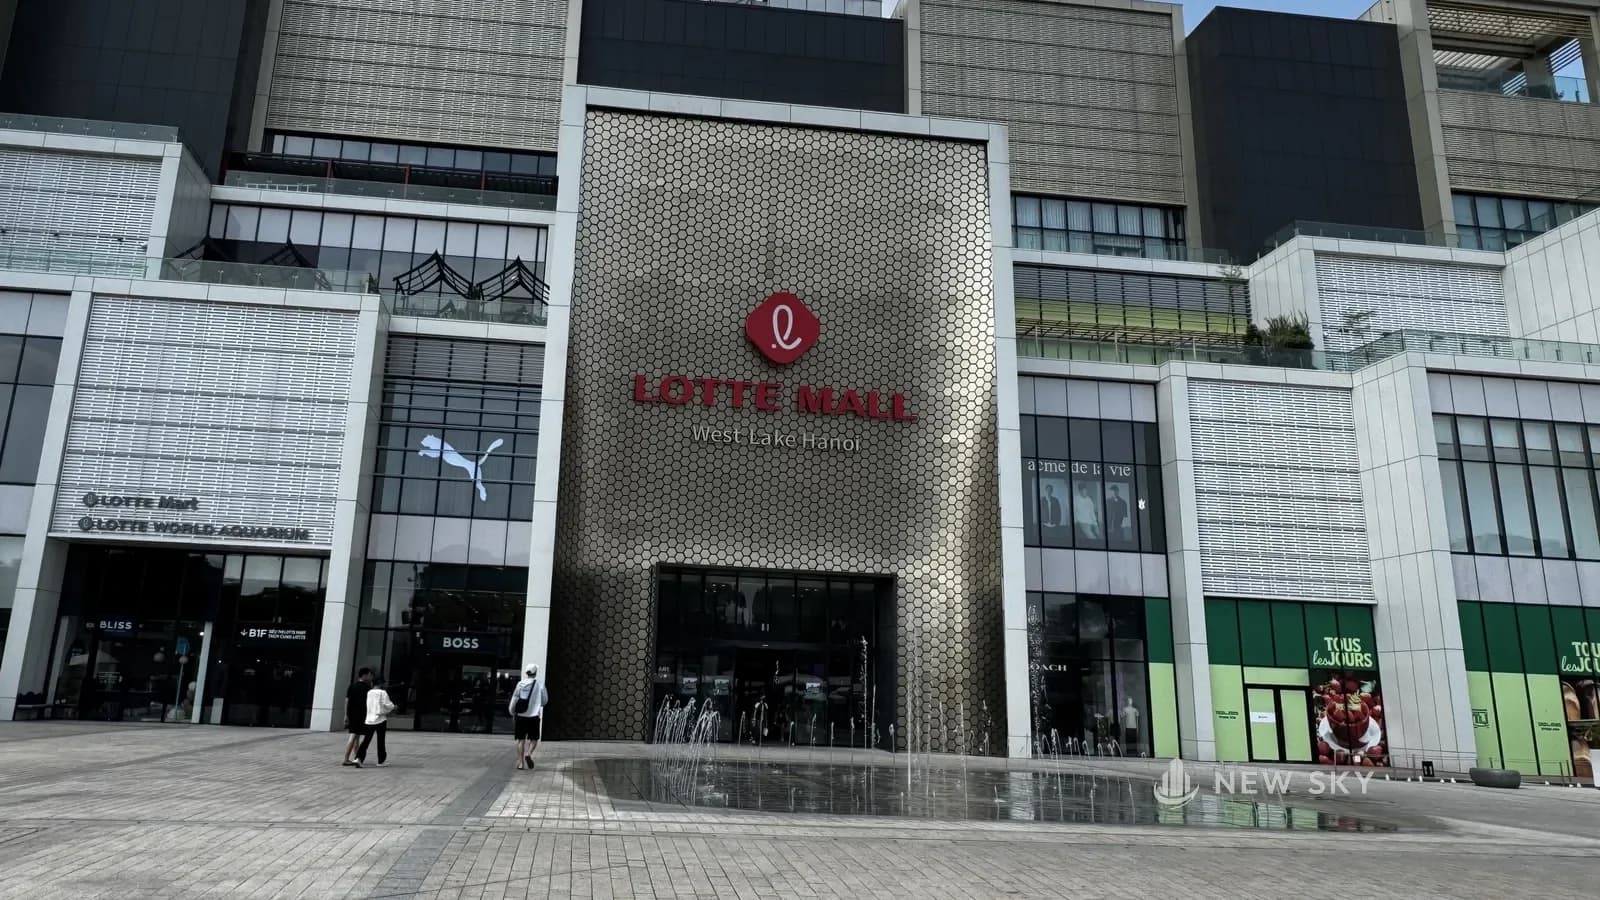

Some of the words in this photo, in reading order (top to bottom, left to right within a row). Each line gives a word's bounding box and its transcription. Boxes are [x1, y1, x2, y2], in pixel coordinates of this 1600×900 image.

[634, 374, 782, 411] LOTTE
[797, 384, 919, 422] MALL
[693, 424, 742, 444] West
[749, 428, 796, 449] Lake
[802, 432, 862, 452] Hanoi
[1071, 461, 1088, 475] de
[102, 494, 155, 509] LOTTE
[159, 496, 199, 510] Mart
[96, 518, 149, 532] LOTTE
[154, 521, 215, 535] WORLD
[216, 524, 309, 541] AQUARIUM
[99, 620, 133, 630] BLISS
[248, 628, 268, 638] B1F
[442, 636, 480, 649] BOSS
[1323, 636, 1362, 652] TOUS
[1571, 641, 1600, 657] TOU
[1312, 649, 1330, 666] les
[1328, 652, 1373, 668] JOURS
[1561, 655, 1579, 672] les
[1577, 657, 1600, 673] JOU
